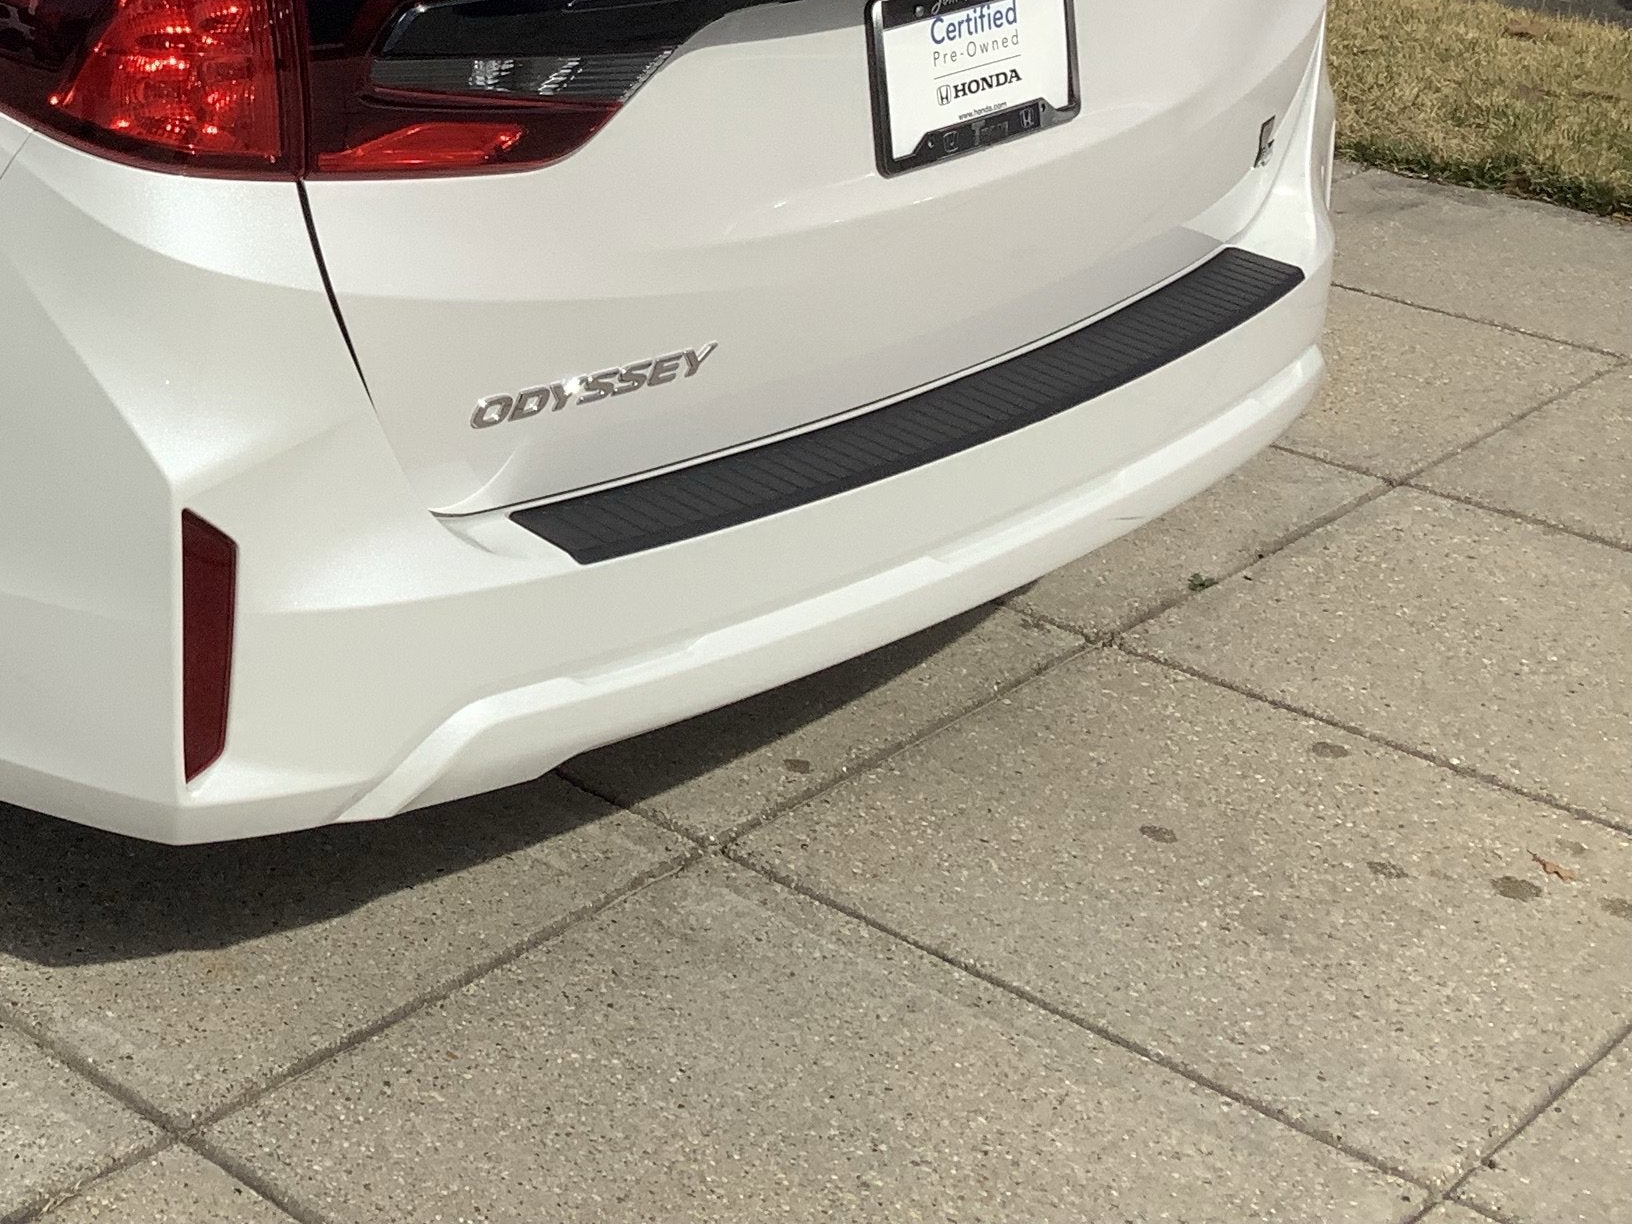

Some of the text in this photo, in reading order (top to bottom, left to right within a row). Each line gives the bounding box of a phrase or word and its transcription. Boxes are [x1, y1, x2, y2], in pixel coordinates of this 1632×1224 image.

[932, 29, 1019, 67] Pre-Owned
[953, 68, 1023, 99] HONDA
[470, 340, 718, 429] ODYSSEY
